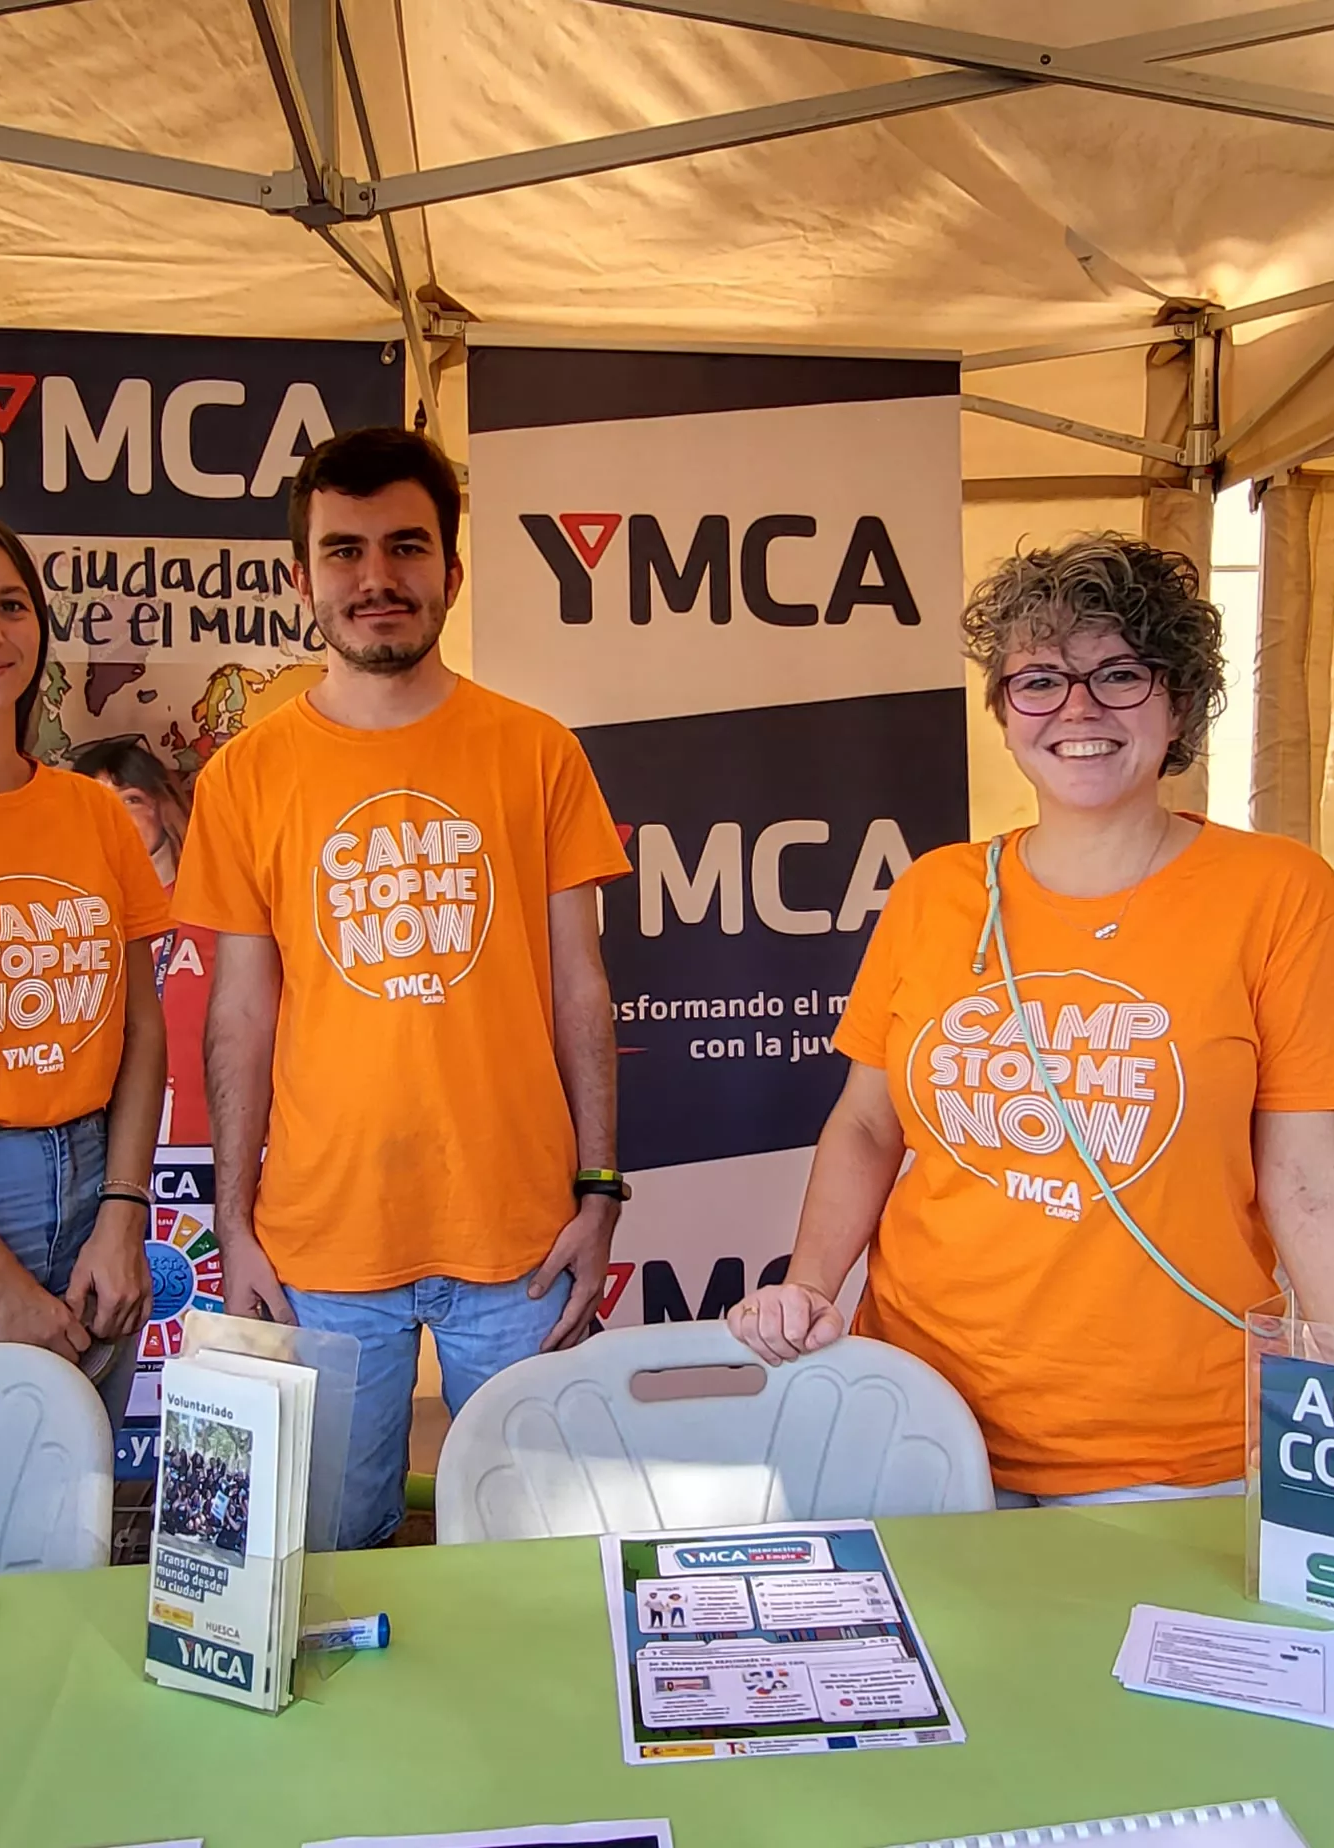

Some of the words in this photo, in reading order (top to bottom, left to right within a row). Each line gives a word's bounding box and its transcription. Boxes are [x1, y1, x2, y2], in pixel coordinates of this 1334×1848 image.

[518, 512, 922, 627] YMCA
[48, 601, 113, 645] ve
[127, 601, 173, 648] el
[322, 820, 482, 881] CAMP
[329, 868, 422, 918] STOP
[424, 867, 478, 901] ME
[597, 818, 918, 938] MCA
[339, 903, 476, 969] NOW
[63, 939, 112, 974] ME
[384, 973, 445, 1001] YMCA
[794, 989, 818, 1016] el
[941, 995, 1170, 1051] CAMP
[2, 1043, 65, 1071] YMCA
[690, 1037, 746, 1060] con
[756, 1031, 782, 1057] la
[790, 1030, 836, 1063] juv
[928, 1043, 1072, 1093] STOP
[1075, 1055, 1156, 1101] ME
[935, 1088, 1152, 1166] NOW
[151, 1171, 201, 1199] CA
[1004, 1169, 1082, 1211] YMCA
[1044, 1205, 1080, 1222] CAMPS
[167, 1391, 234, 1420] Voluntariado
[157, 1549, 215, 1576] Transforma
[218, 1568, 228, 1581] el
[683, 1549, 748, 1564] YMCA
[155, 1576, 167, 1589] tu
[168, 1580, 203, 1601] ciudad
[156, 1565, 190, 1583] mundo
[192, 1573, 223, 1594] desde
[206, 1621, 241, 1640] HUESCA
[176, 1636, 247, 1685] YMCA
